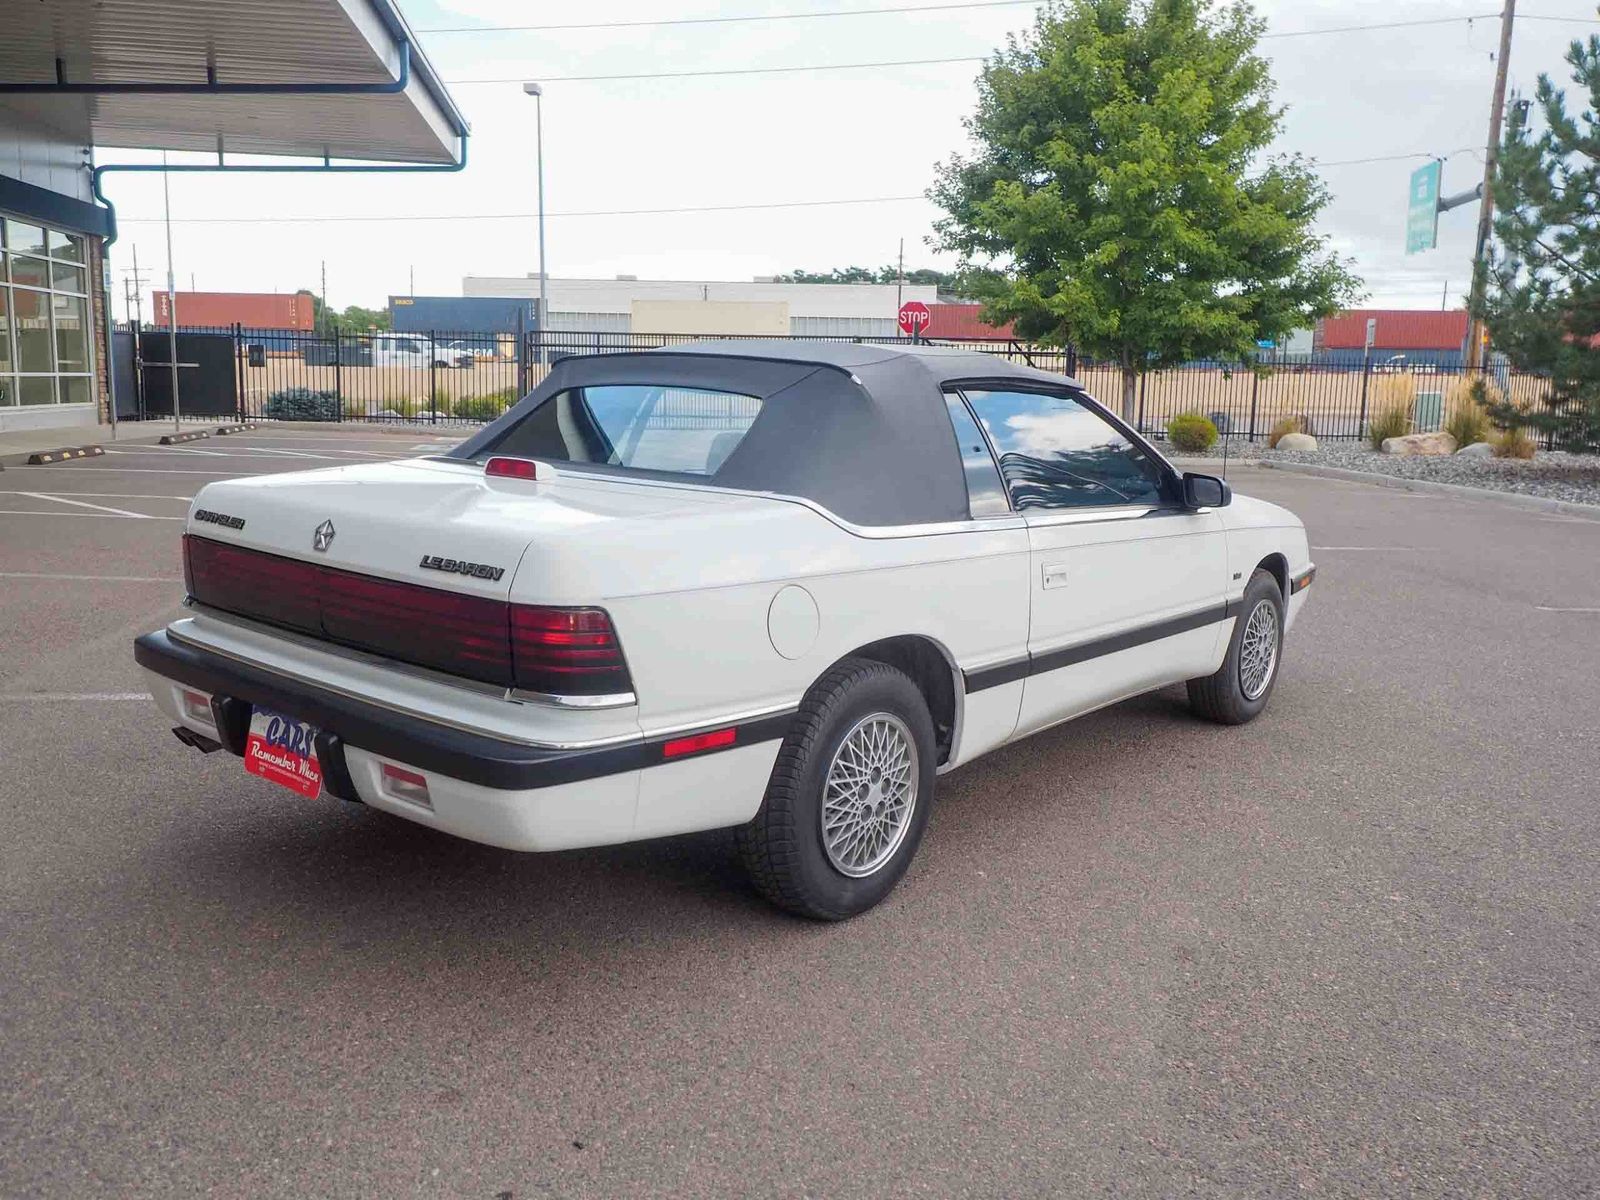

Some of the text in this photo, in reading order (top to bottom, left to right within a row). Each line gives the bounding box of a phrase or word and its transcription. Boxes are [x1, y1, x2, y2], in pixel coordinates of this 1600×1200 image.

[900, 311, 928, 324] STOP
[266, 717, 315, 759] CARS
[250, 740, 297, 773] Remember
[298, 757, 320, 783] When
